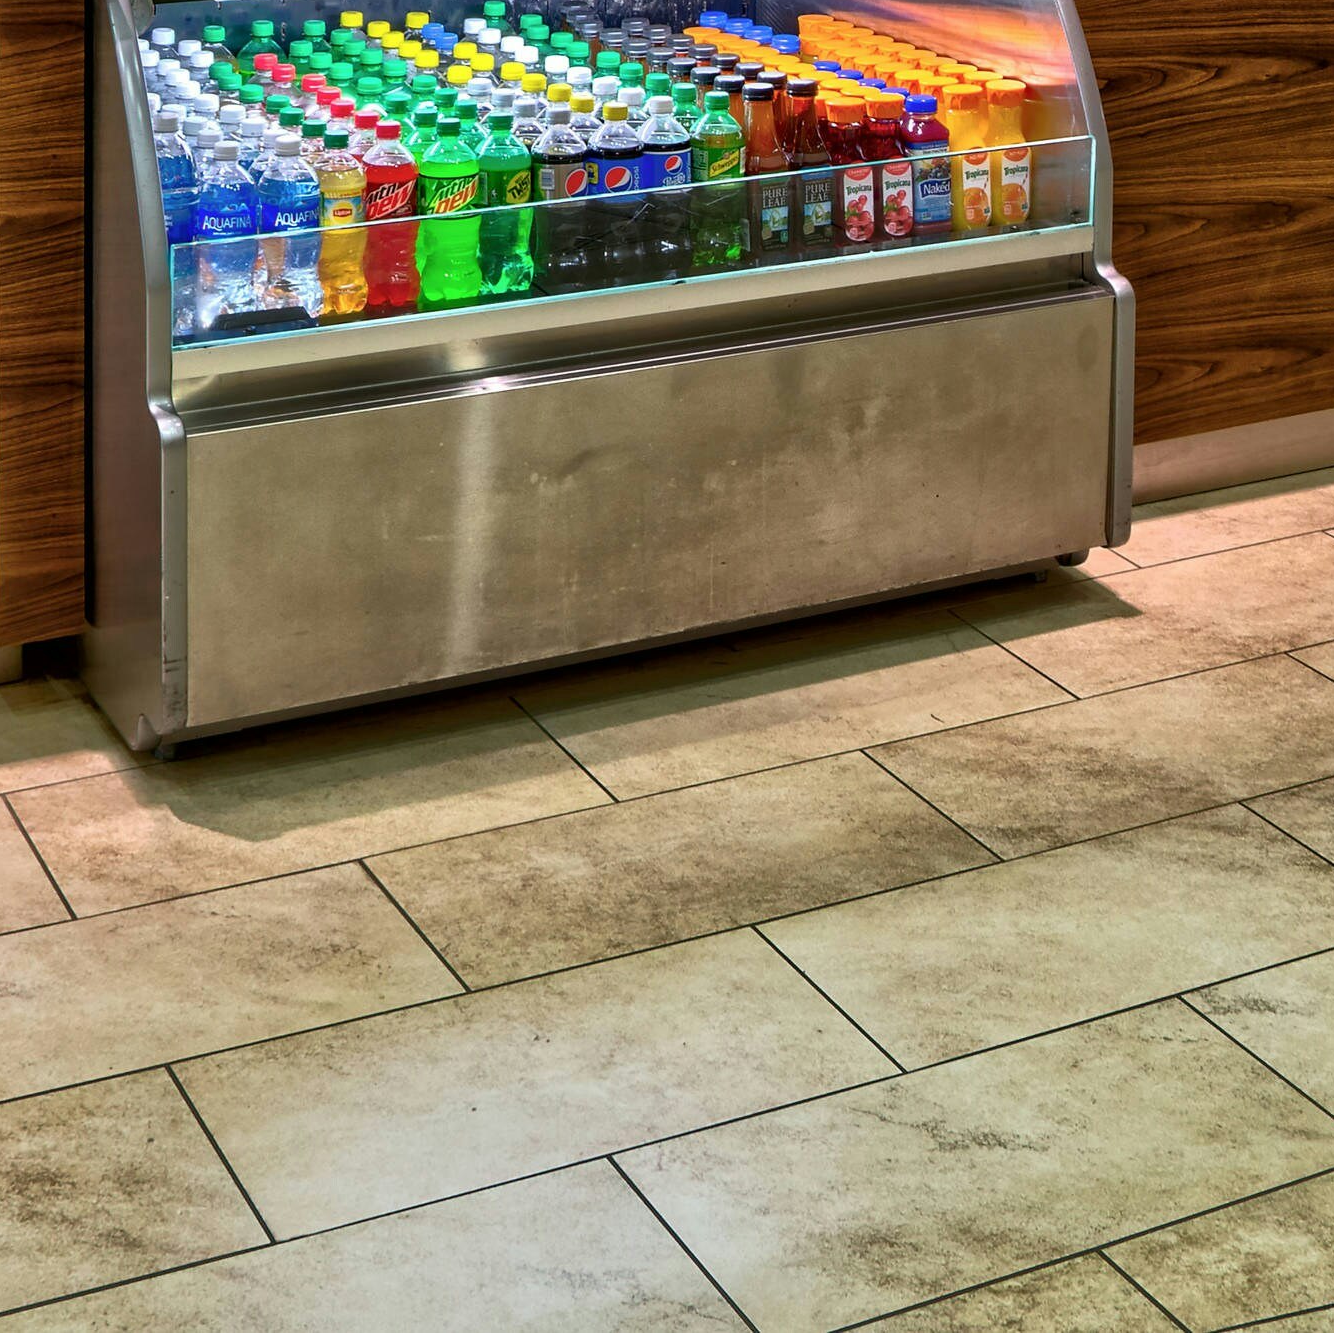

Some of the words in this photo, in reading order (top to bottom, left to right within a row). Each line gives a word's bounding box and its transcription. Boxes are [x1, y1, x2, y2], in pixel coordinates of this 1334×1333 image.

[965, 168, 989, 180] Tropicana
[1003, 165, 1029, 177] Tropicana
[805, 183, 831, 194] PURE
[845, 184, 872, 196] Tropicana
[885, 179, 911, 191] Tropicana
[923, 181, 951, 196] Naked
[763, 188, 788, 200] PURE
[805, 192, 829, 203] LEAF
[763, 198, 787, 208] LEAF
[203, 216, 252, 231] AQUAFINA
